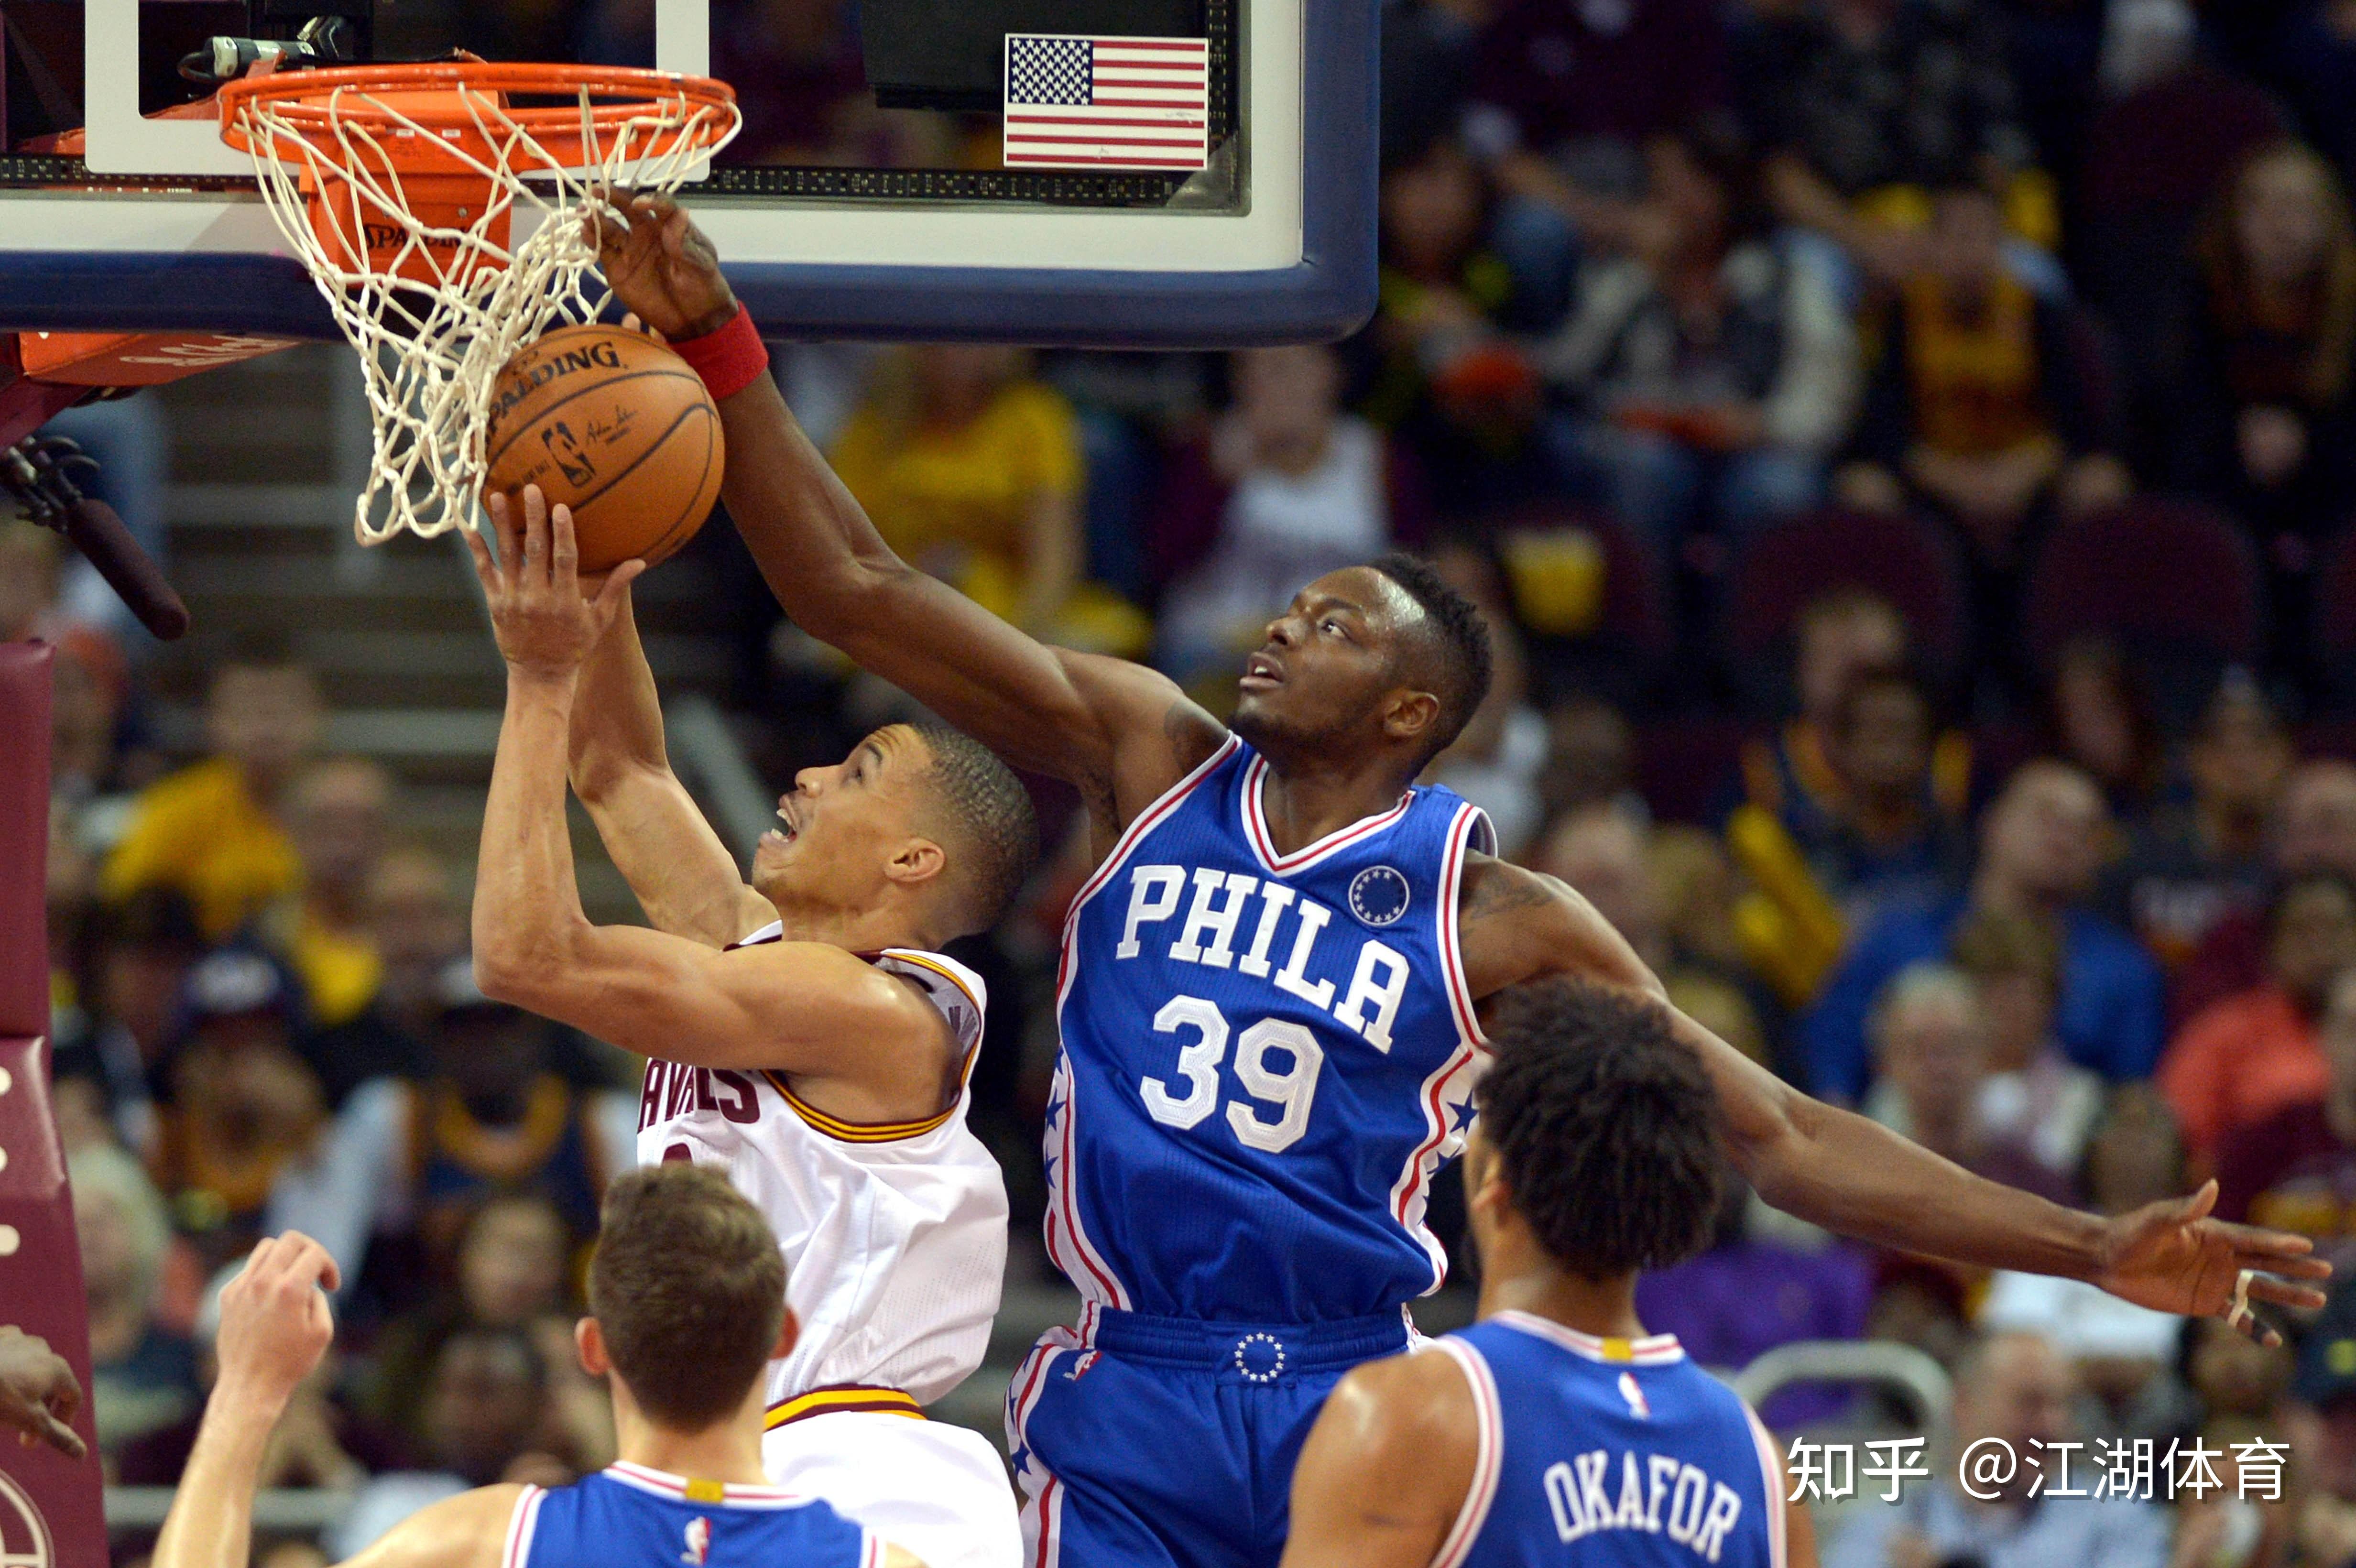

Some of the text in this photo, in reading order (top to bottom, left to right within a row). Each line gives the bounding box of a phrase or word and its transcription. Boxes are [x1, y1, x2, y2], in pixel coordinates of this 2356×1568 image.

[1116, 865, 1410, 1054] PHILA
[1139, 994, 1324, 1154] 39
[1544, 1449, 1742, 1564] OKAFOR
